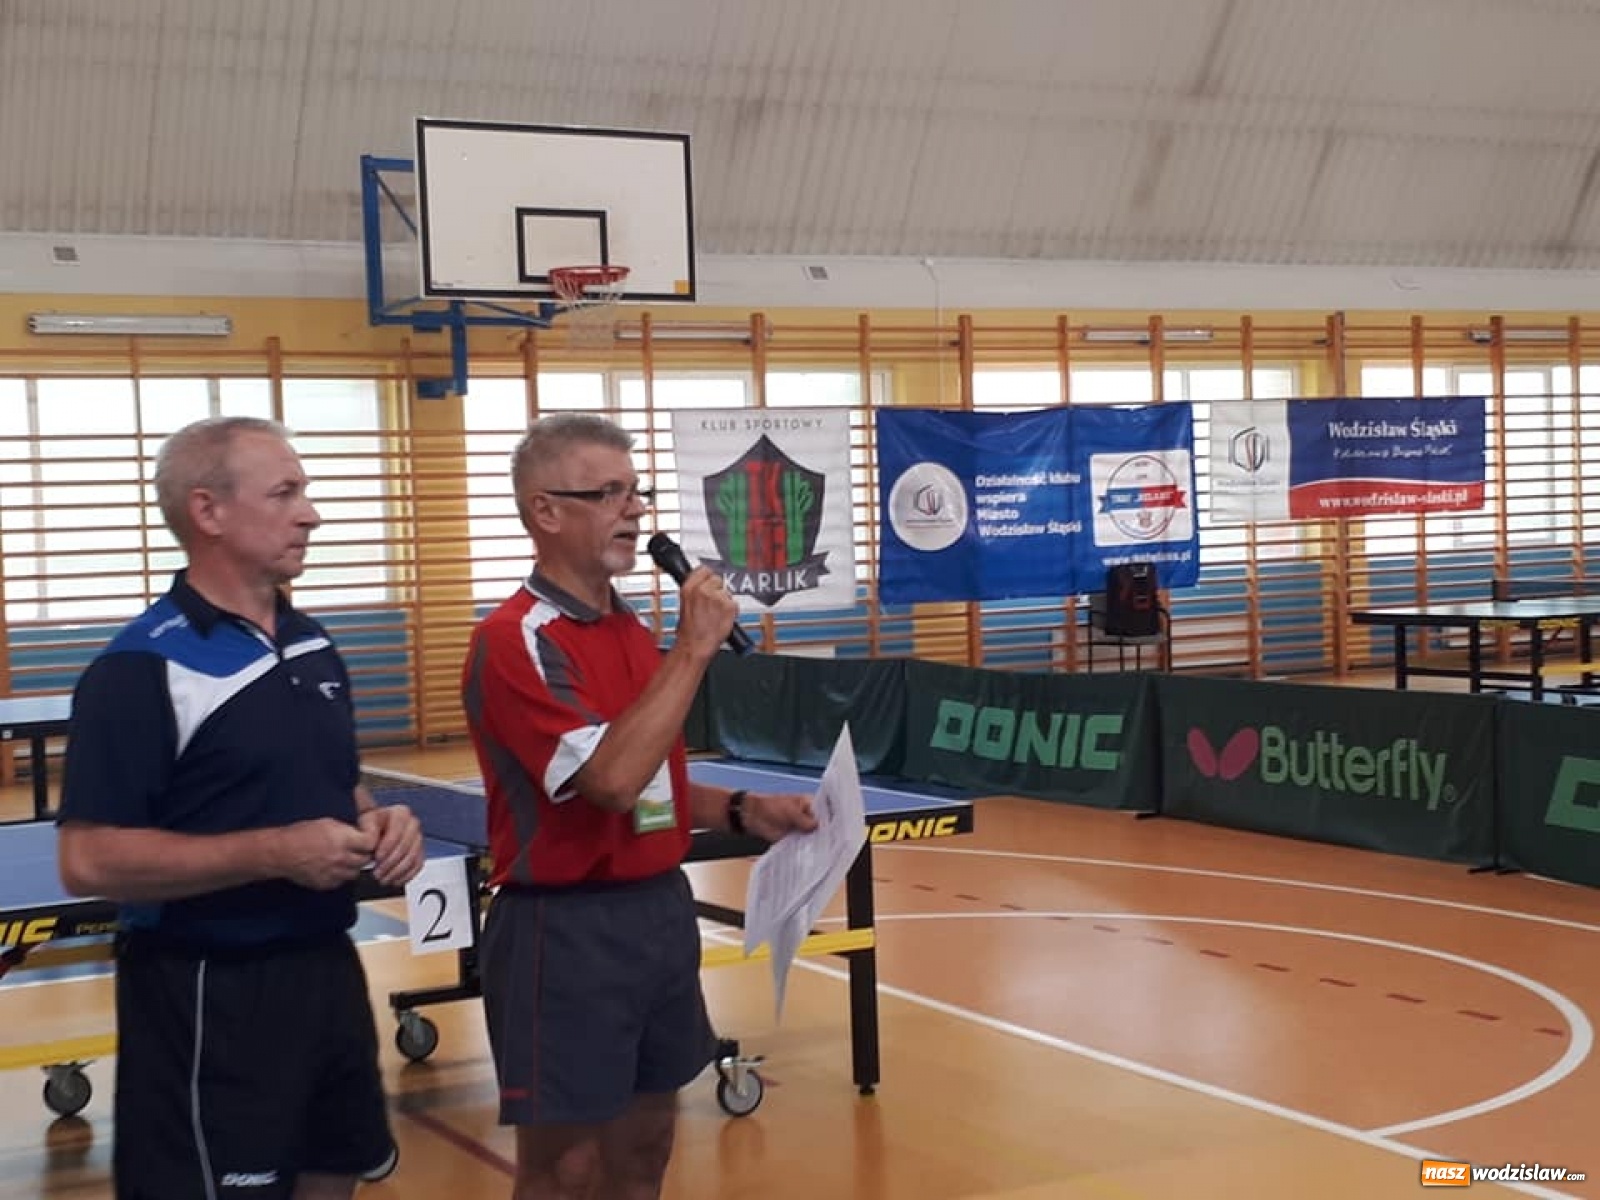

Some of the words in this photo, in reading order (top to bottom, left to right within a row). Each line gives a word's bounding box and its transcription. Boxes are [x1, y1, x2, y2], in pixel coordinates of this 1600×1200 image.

[701, 419, 737, 431] KLUB
[744, 418, 824, 431] SPORTOWY
[1328, 419, 1408, 439] Wodzisław
[723, 569, 809, 593] KARLIK
[929, 698, 1125, 773] DONIC
[1258, 723, 1449, 811] Butterfly
[418, 887, 454, 944] 2
